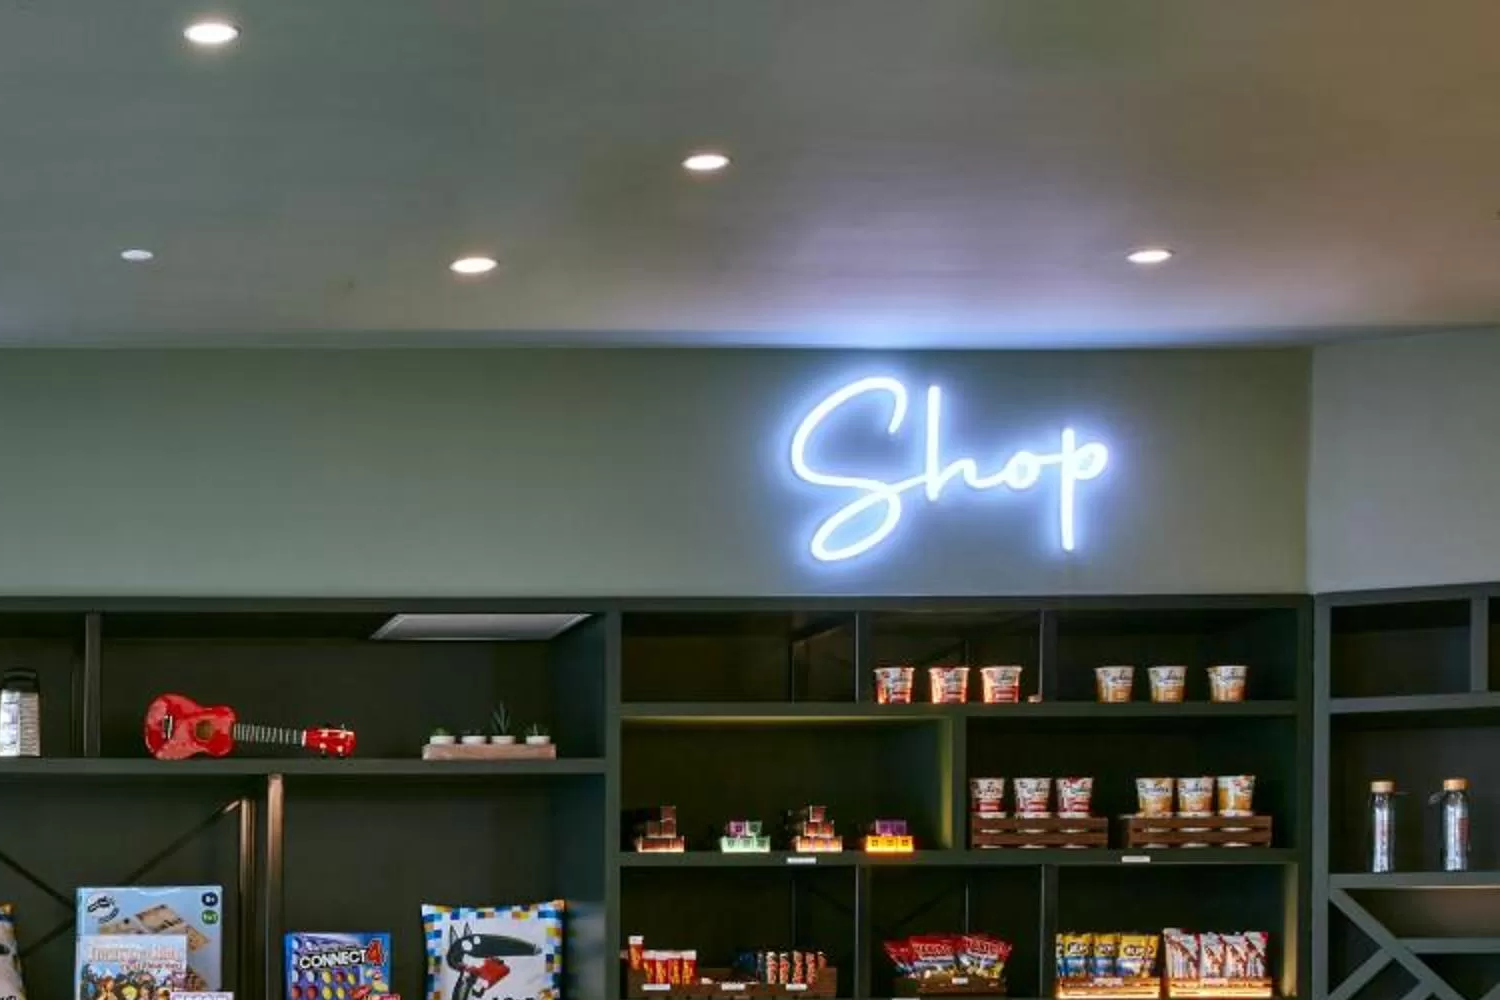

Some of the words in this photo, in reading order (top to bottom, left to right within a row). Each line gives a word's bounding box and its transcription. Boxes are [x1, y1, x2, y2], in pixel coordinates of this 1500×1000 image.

[790, 376, 1109, 562] Shop
[299, 949, 366, 969] CONNECT
[367, 939, 384, 965] 4
